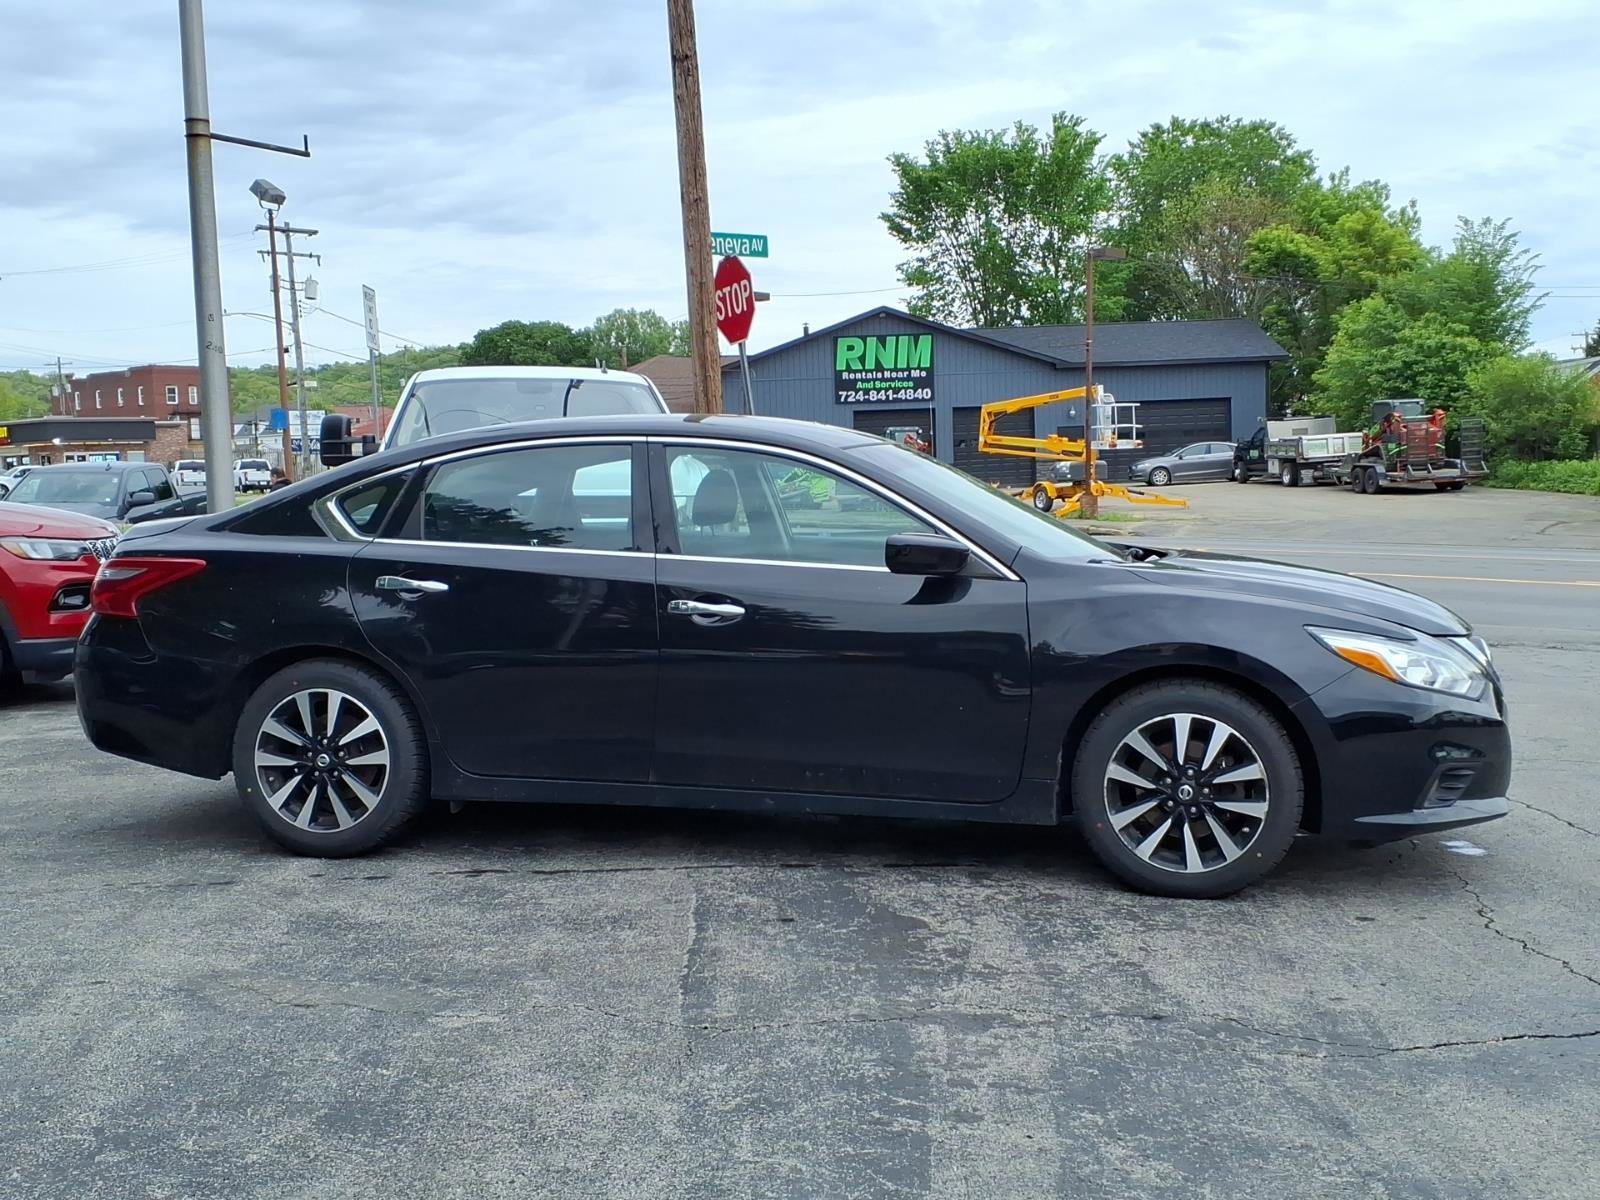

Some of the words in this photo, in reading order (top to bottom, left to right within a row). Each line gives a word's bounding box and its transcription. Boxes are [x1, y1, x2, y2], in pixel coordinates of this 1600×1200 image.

[711, 237, 750, 255] eneva
[751, 238, 763, 252] AV
[715, 279, 750, 321] STOP
[836, 335, 932, 370] RNM
[842, 371, 882, 380] Rentals
[884, 370, 909, 379] Near
[911, 369, 927, 378] Me
[856, 380, 874, 389] And
[875, 380, 914, 388] Services
[838, 388, 932, 402] 724-841-4840
